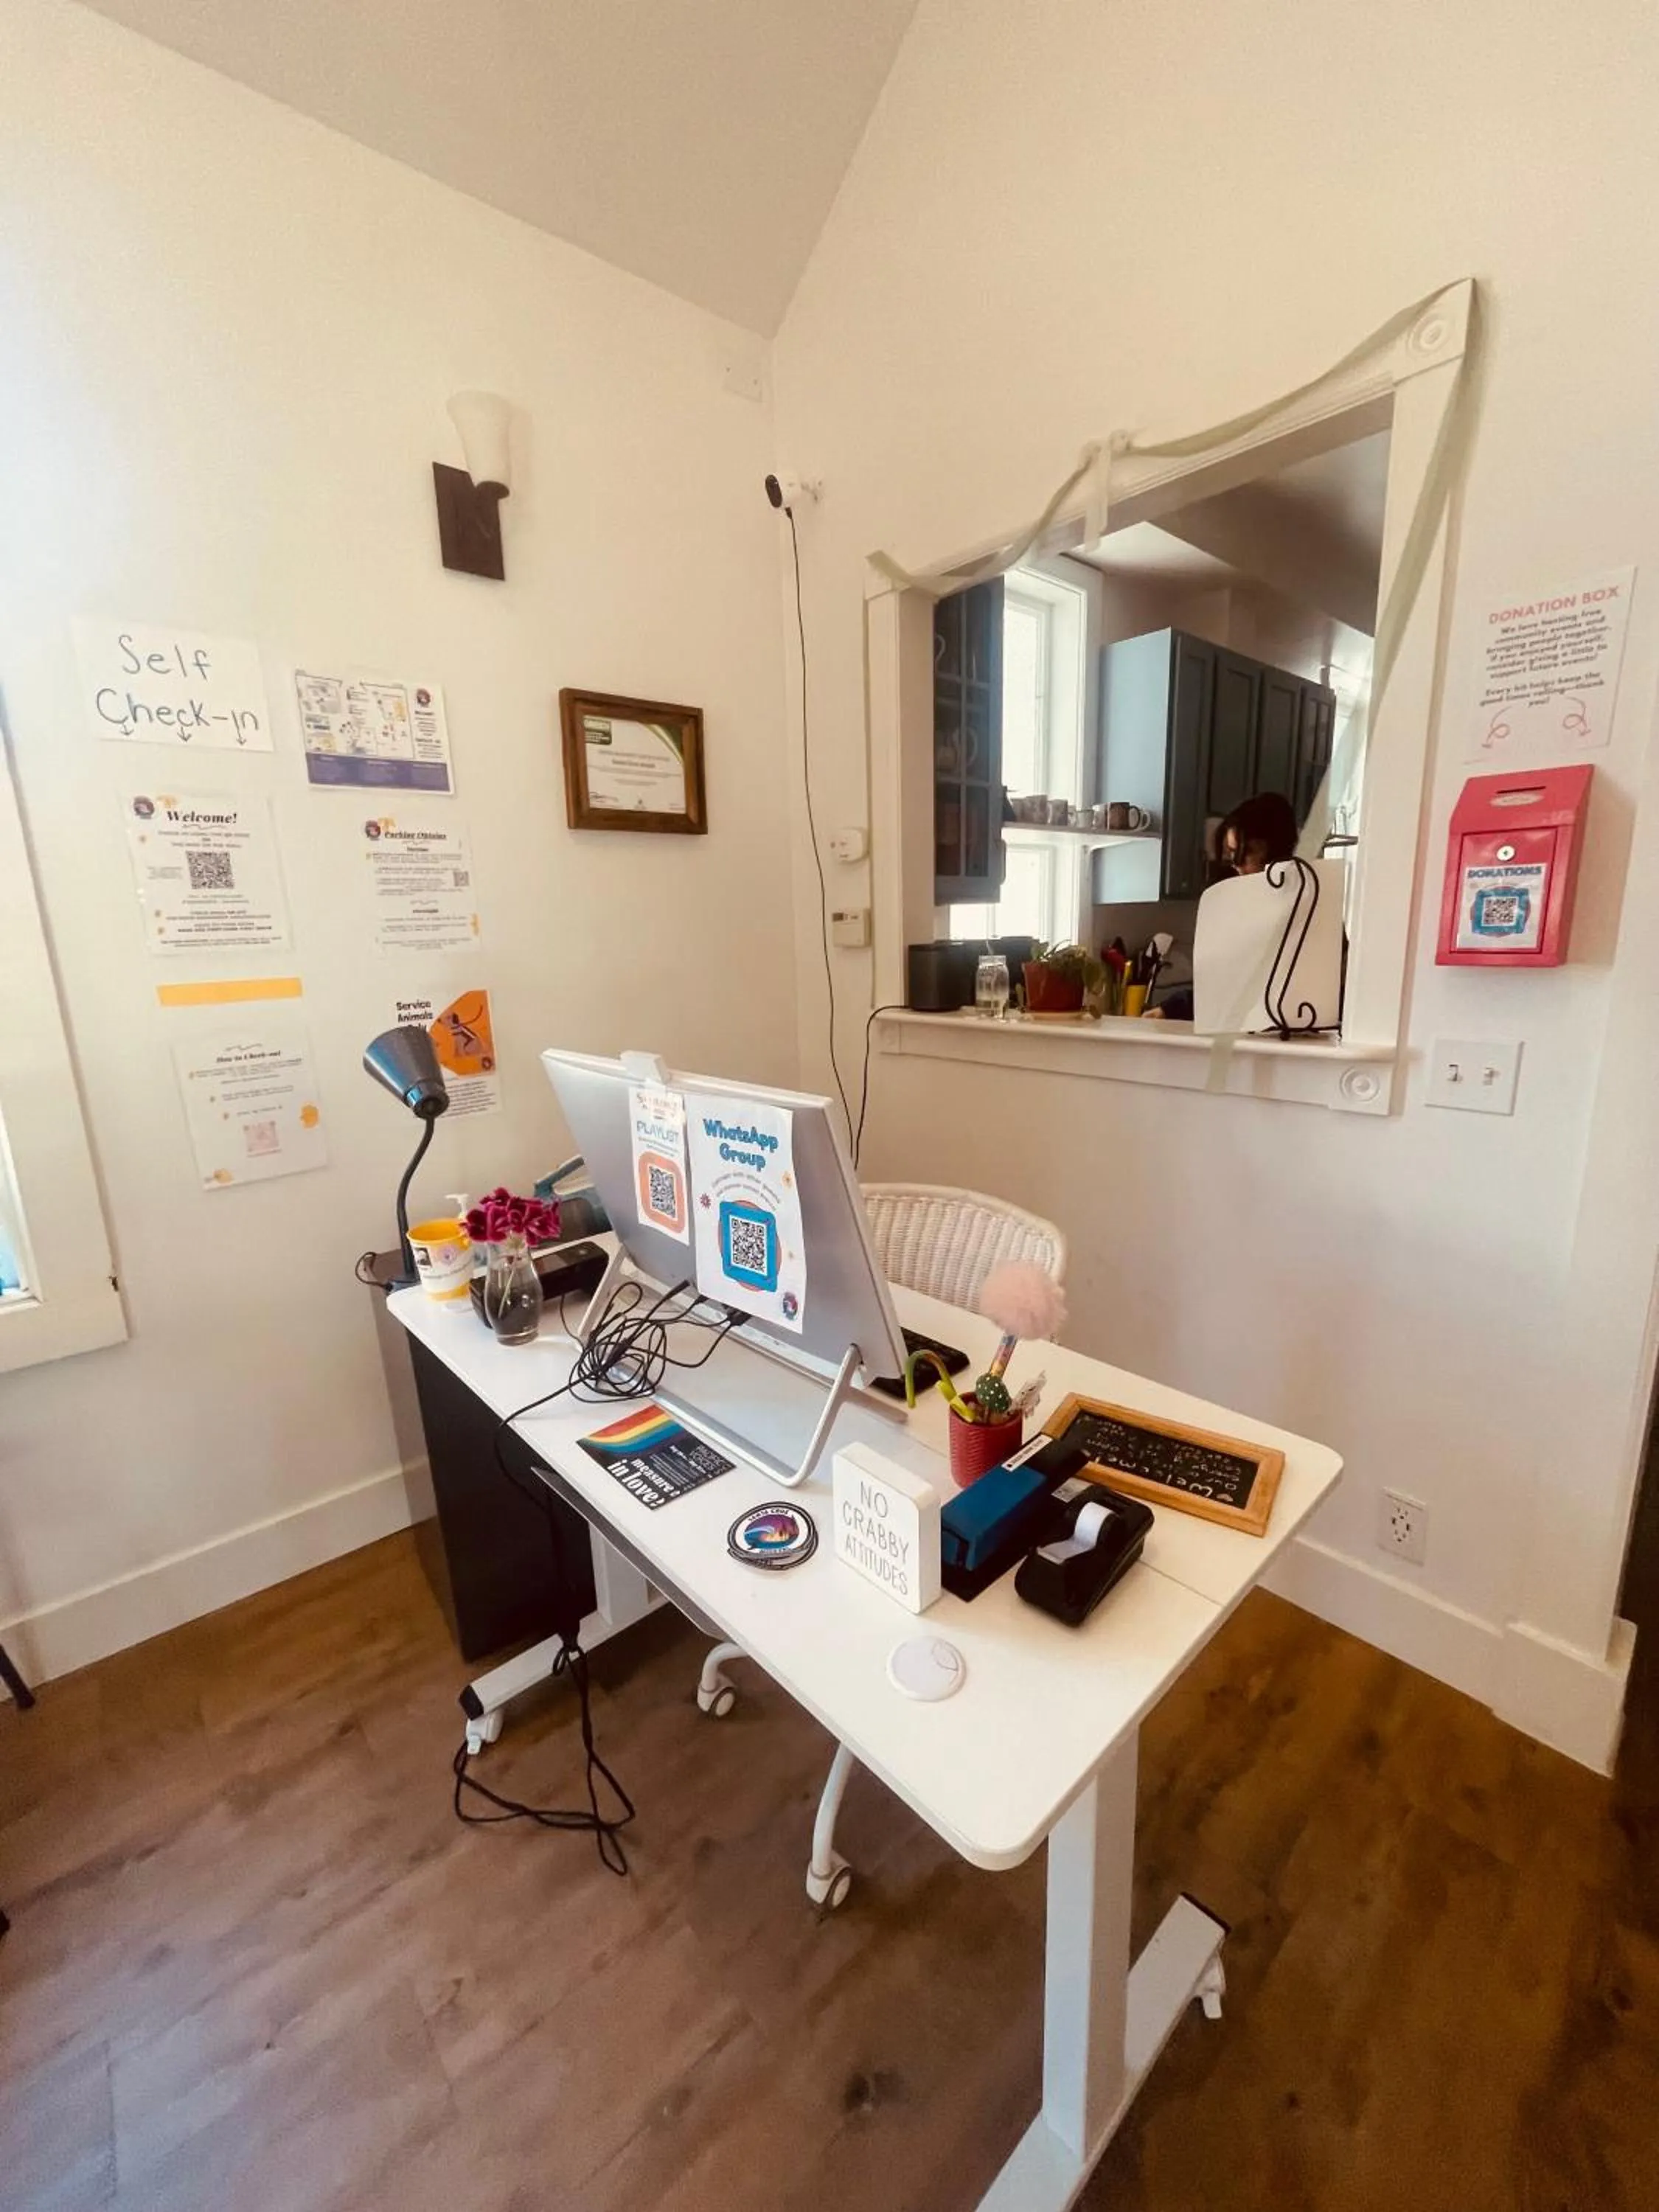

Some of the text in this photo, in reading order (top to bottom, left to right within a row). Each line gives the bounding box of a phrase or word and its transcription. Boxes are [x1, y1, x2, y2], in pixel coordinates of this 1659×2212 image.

[1489, 585, 1619, 625] DONATION BOX
[118, 634, 212, 681] Self
[167, 810, 238, 824] Welcome!
[1467, 866, 1542, 879] DONATIONS
[396, 999, 431, 1011] Service
[397, 1011, 434, 1023] Animals
[636, 1120, 679, 1145] PLAYLIST
[703, 1118, 779, 1154] WhatsApp
[719, 1143, 766, 1172] Group
[607, 1458, 629, 1477] in
[621, 1471, 659, 1503] love
[630, 1458, 675, 1492] measure
[860, 1481, 888, 1518] NO
[842, 1500, 910, 1565] CRABBY
[845, 1533, 908, 1596] ATTITUDES
